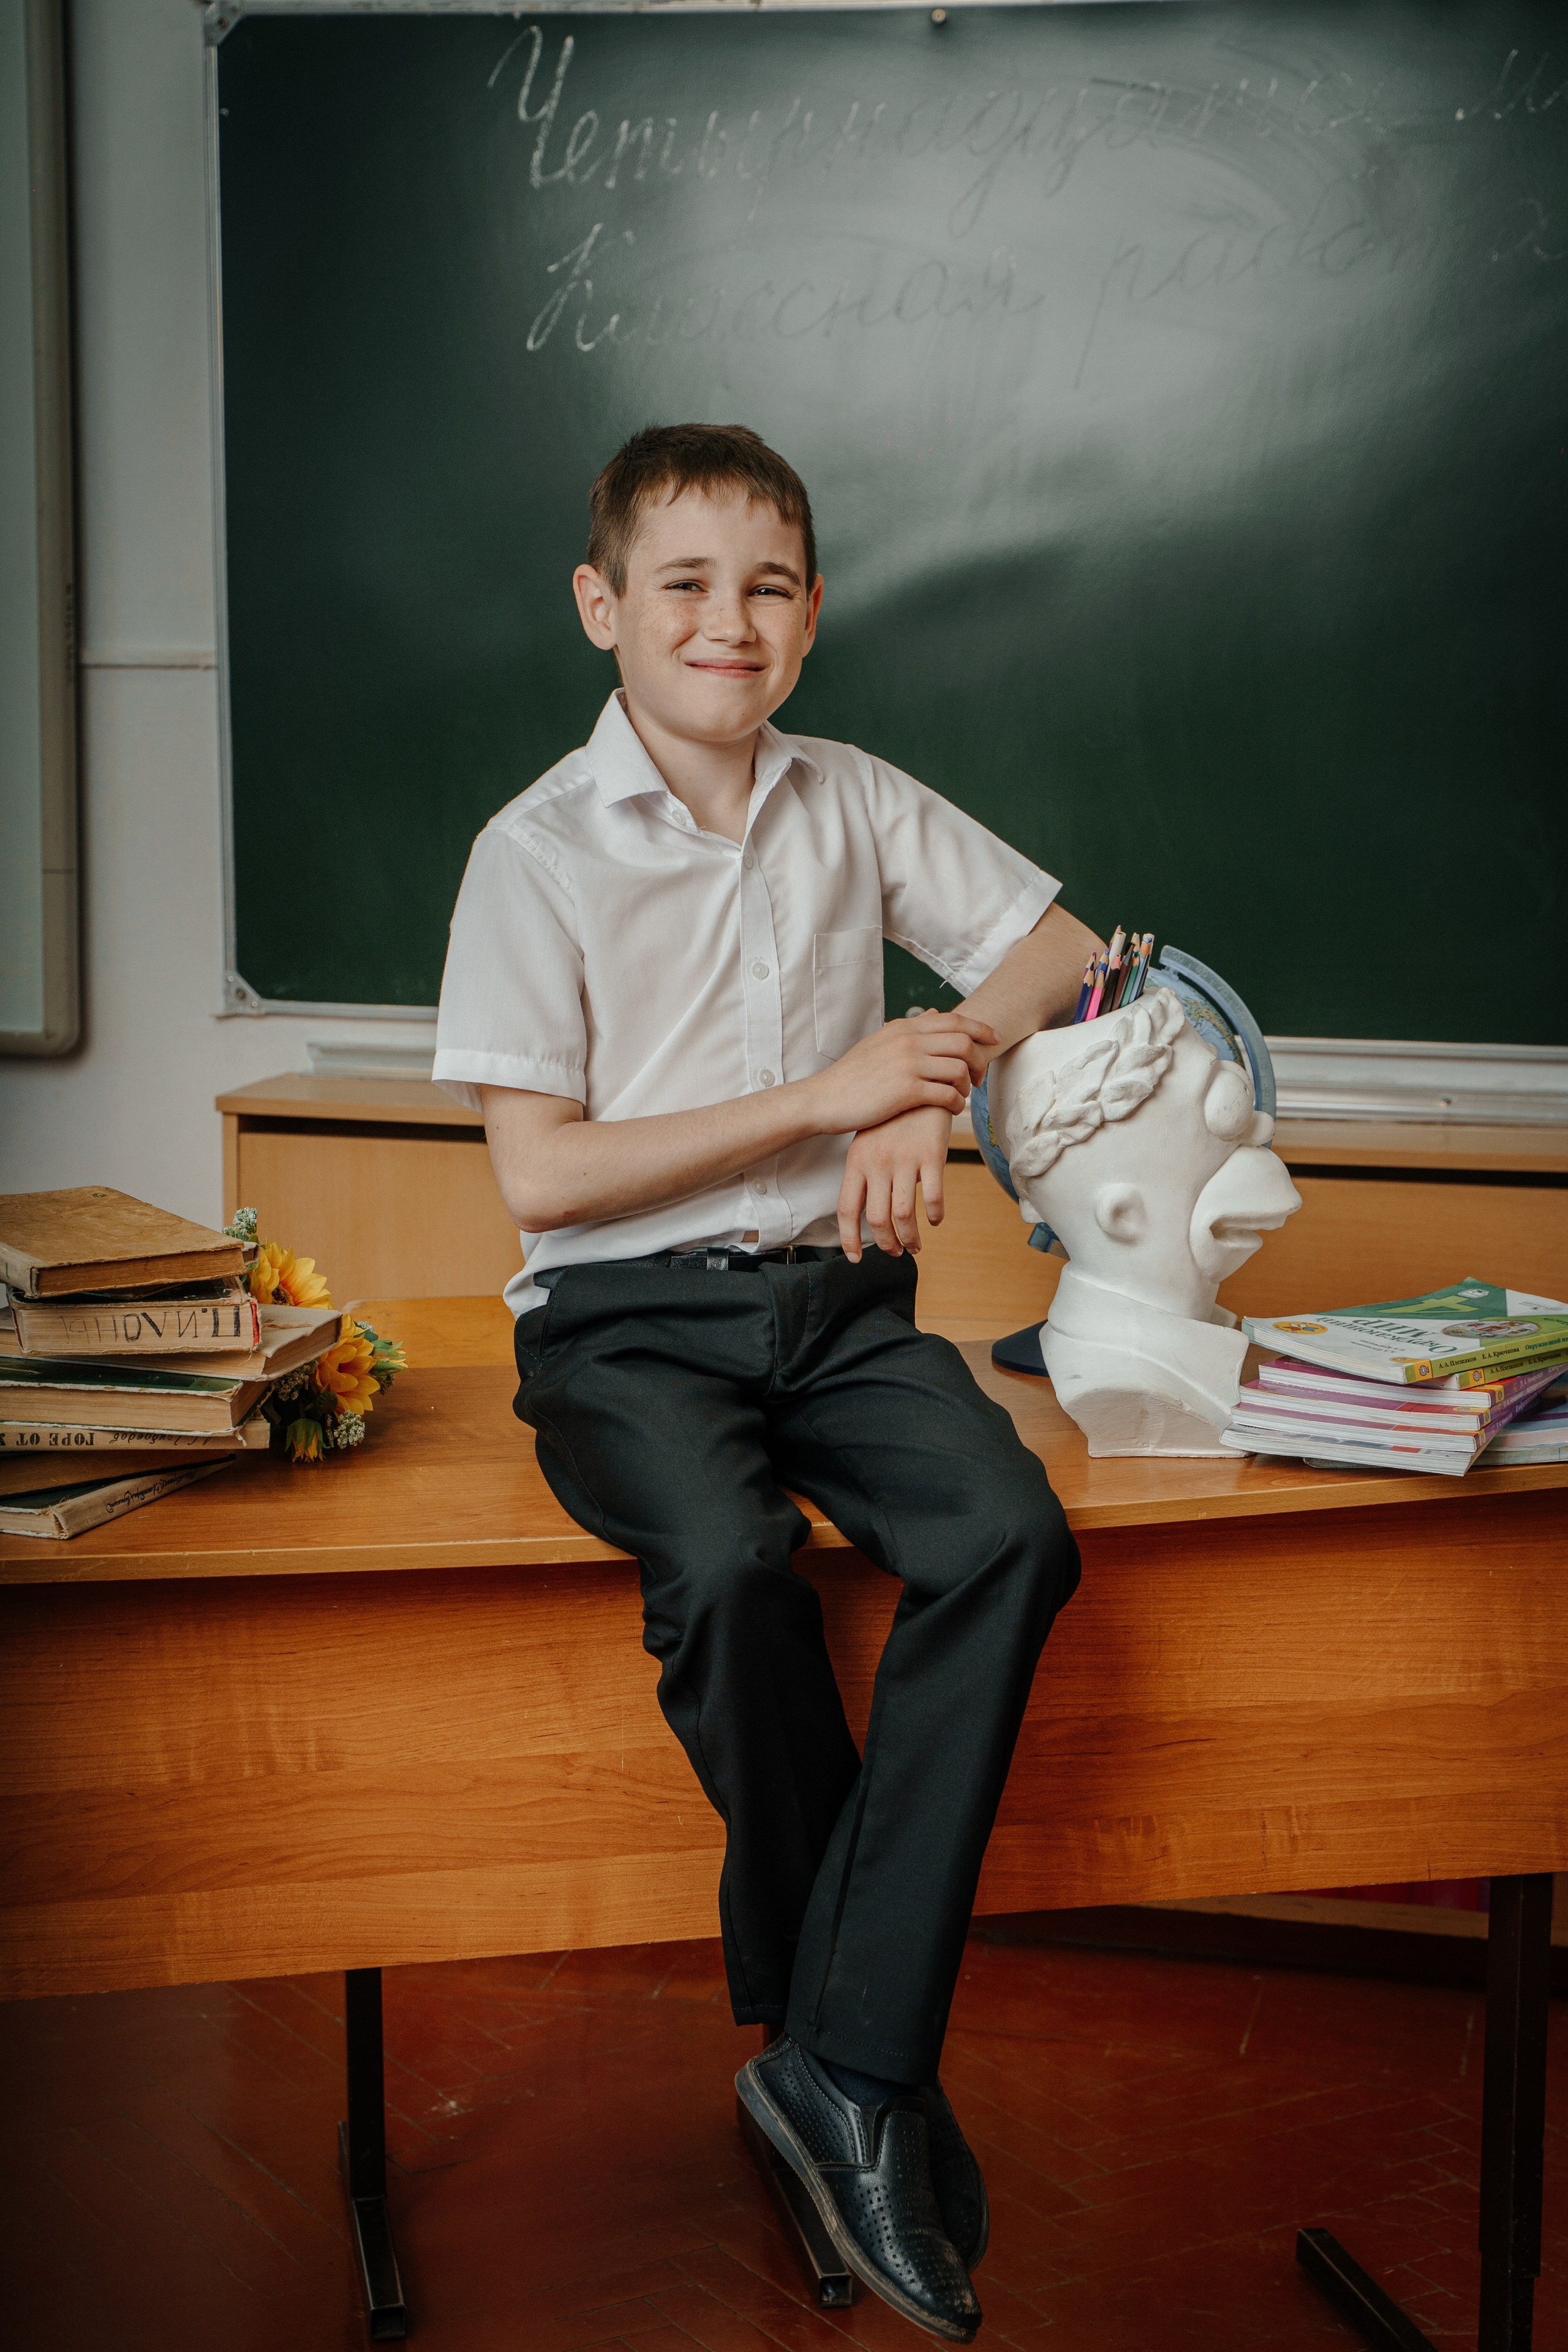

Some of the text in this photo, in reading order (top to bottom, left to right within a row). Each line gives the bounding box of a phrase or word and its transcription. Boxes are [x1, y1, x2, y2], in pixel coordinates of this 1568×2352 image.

[1378, 1295, 1480, 1313] 4
[1314, 1317, 1457, 1353] Окружающий
[1450, 1356, 1477, 1366] Плешаков
[1493, 1348, 1520, 1357] Крючкова
[16, 1433, 40, 1446] ОТ
[49, 1433, 95, 1446] ГОРЕ
